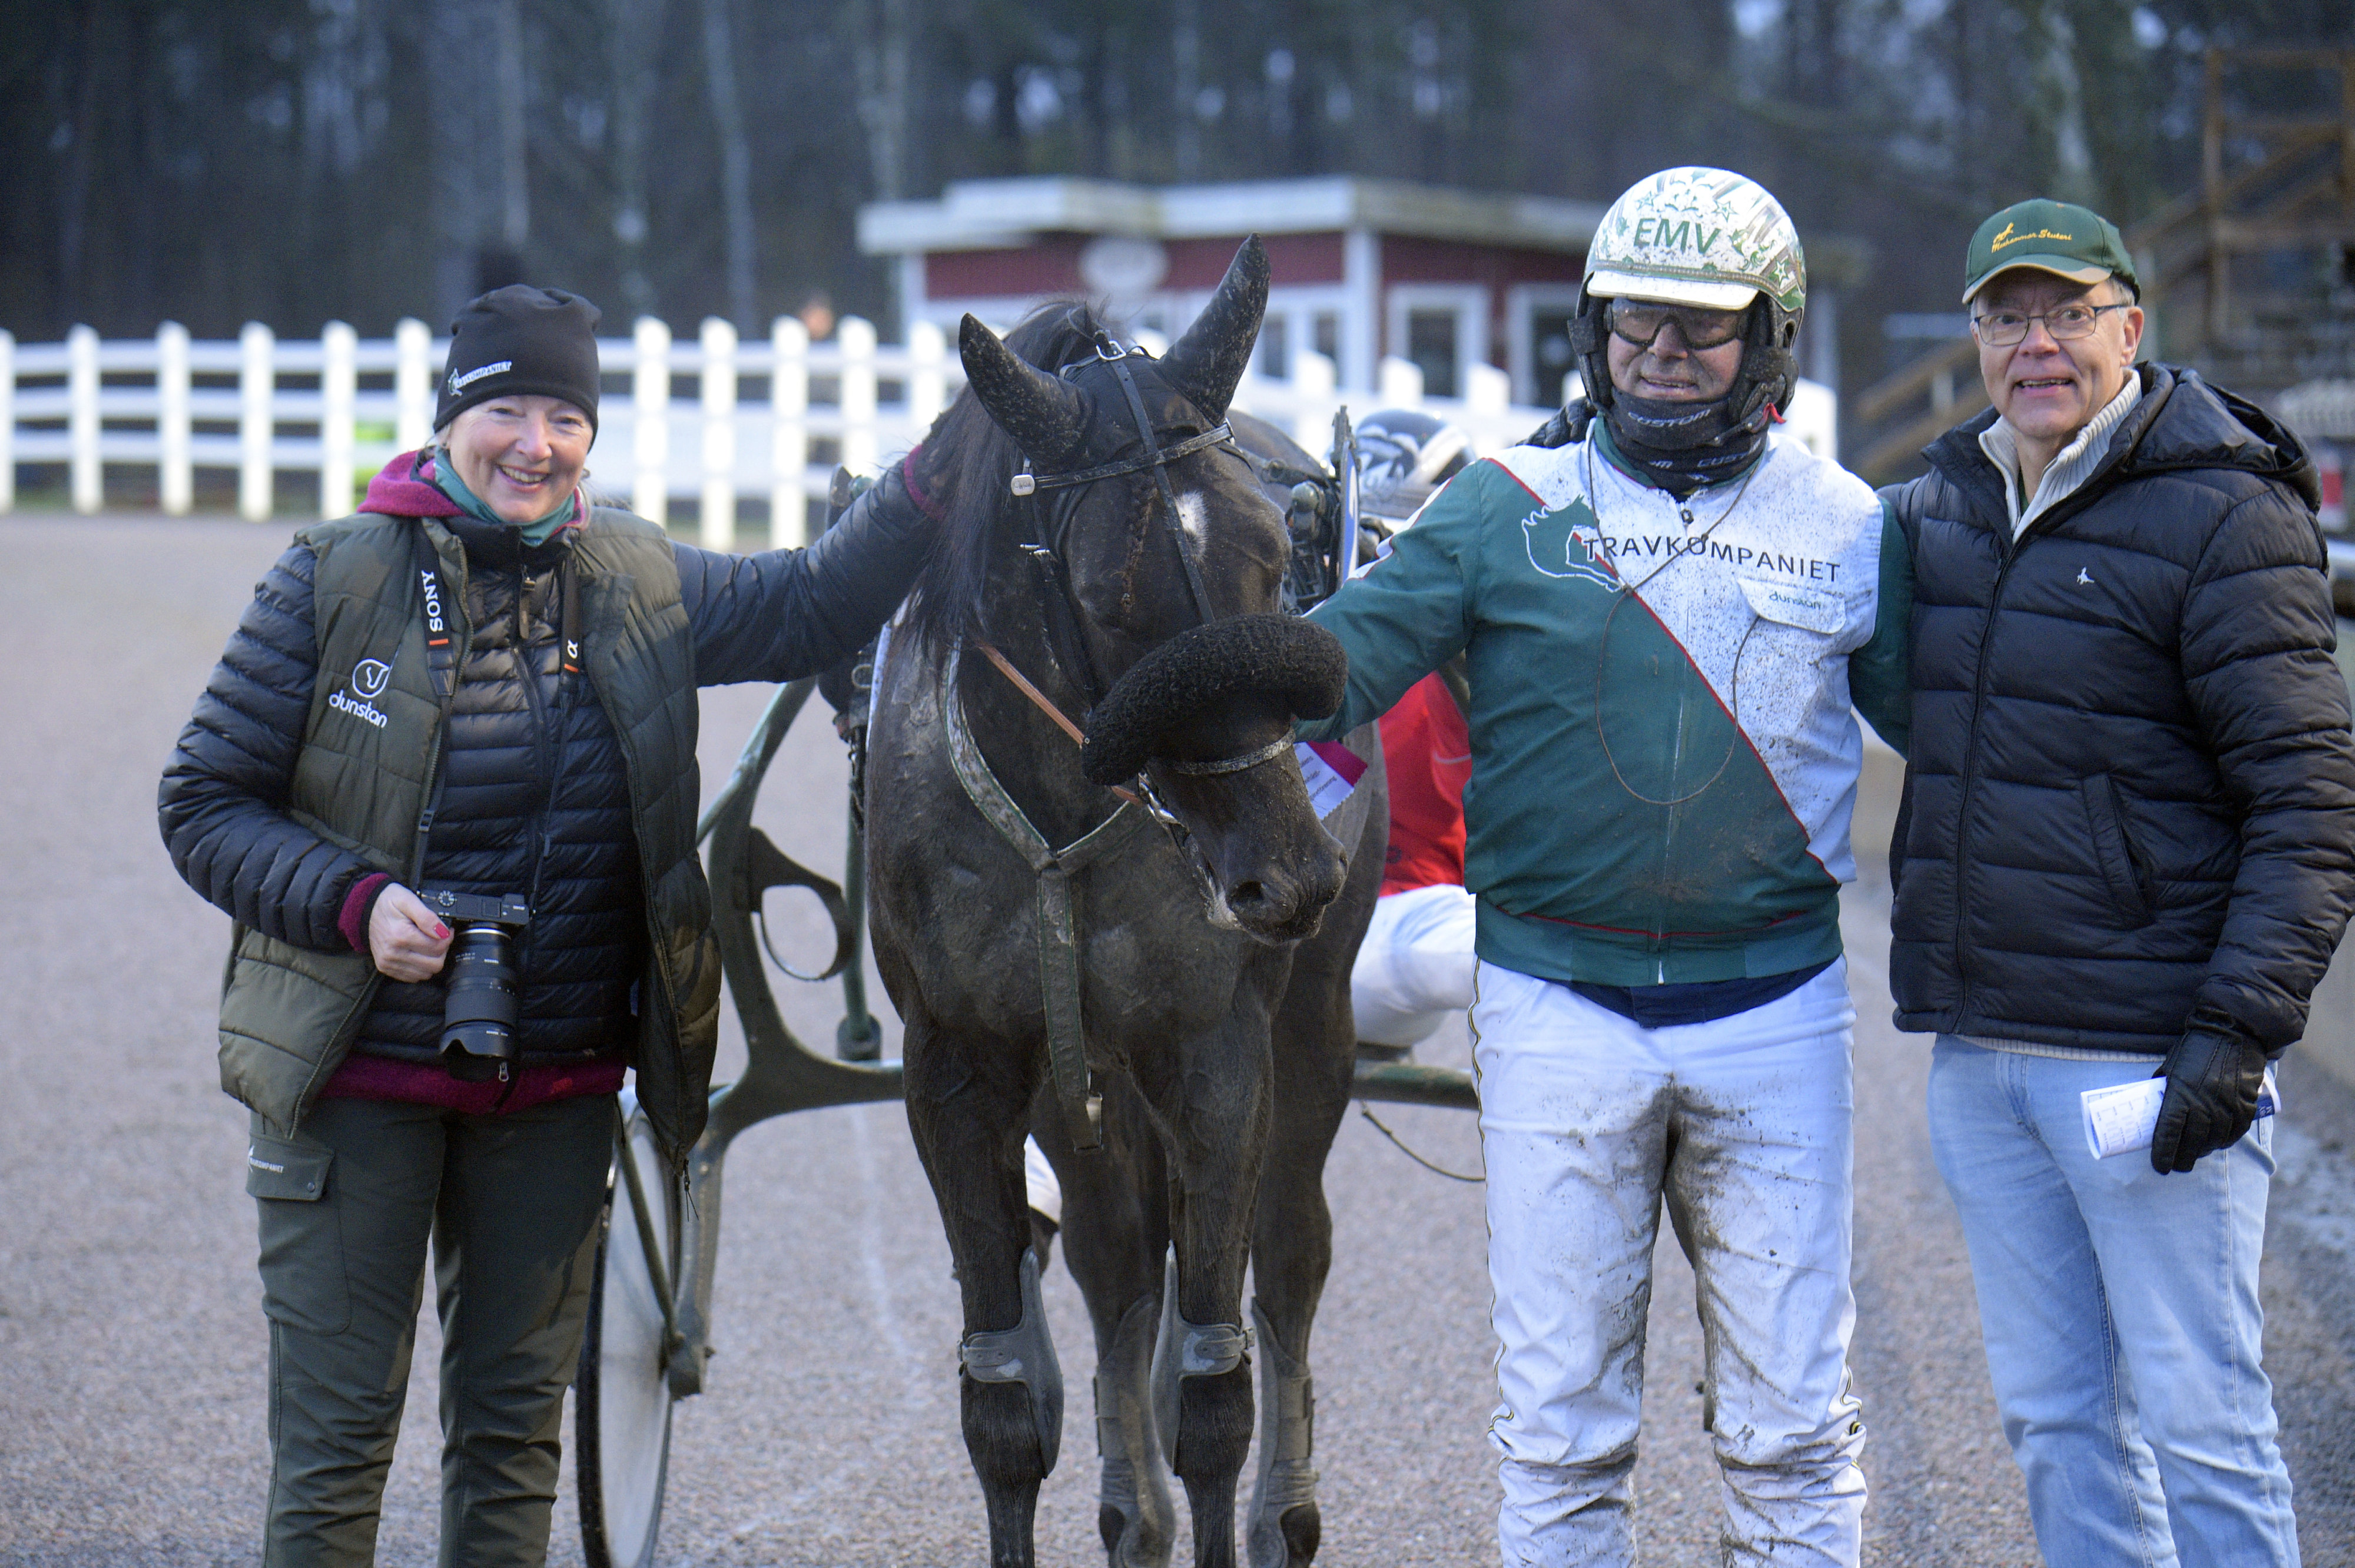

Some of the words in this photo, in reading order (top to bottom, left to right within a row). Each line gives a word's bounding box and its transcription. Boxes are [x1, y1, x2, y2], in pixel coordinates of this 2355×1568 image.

[1633, 218, 1722, 254] EMV
[1584, 535, 1841, 582] TRAVKOMPANIET
[421, 570, 443, 632] SONY
[329, 689, 387, 728] dunstan
